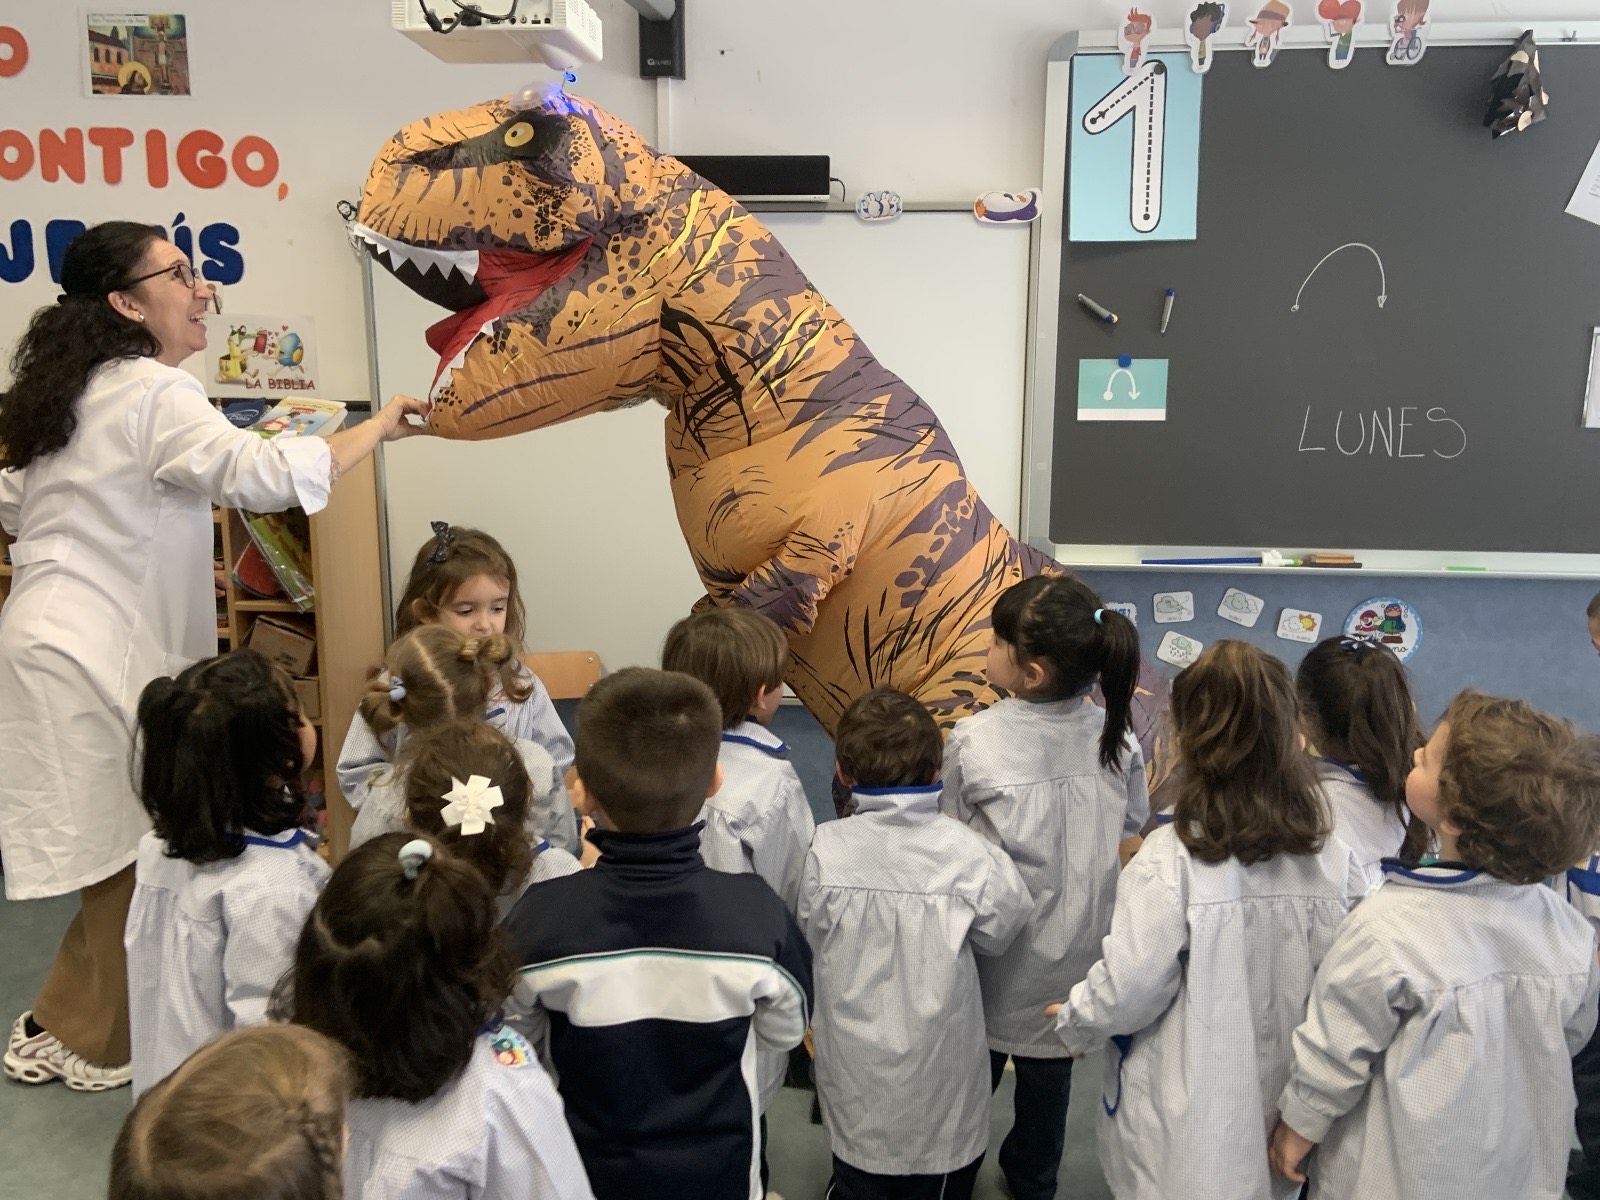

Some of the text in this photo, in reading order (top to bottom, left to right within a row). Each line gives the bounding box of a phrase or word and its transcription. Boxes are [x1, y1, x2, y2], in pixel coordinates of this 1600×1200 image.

[245, 378, 316, 390] LA BIBLIA
[1299, 404, 1467, 458] LUNES
